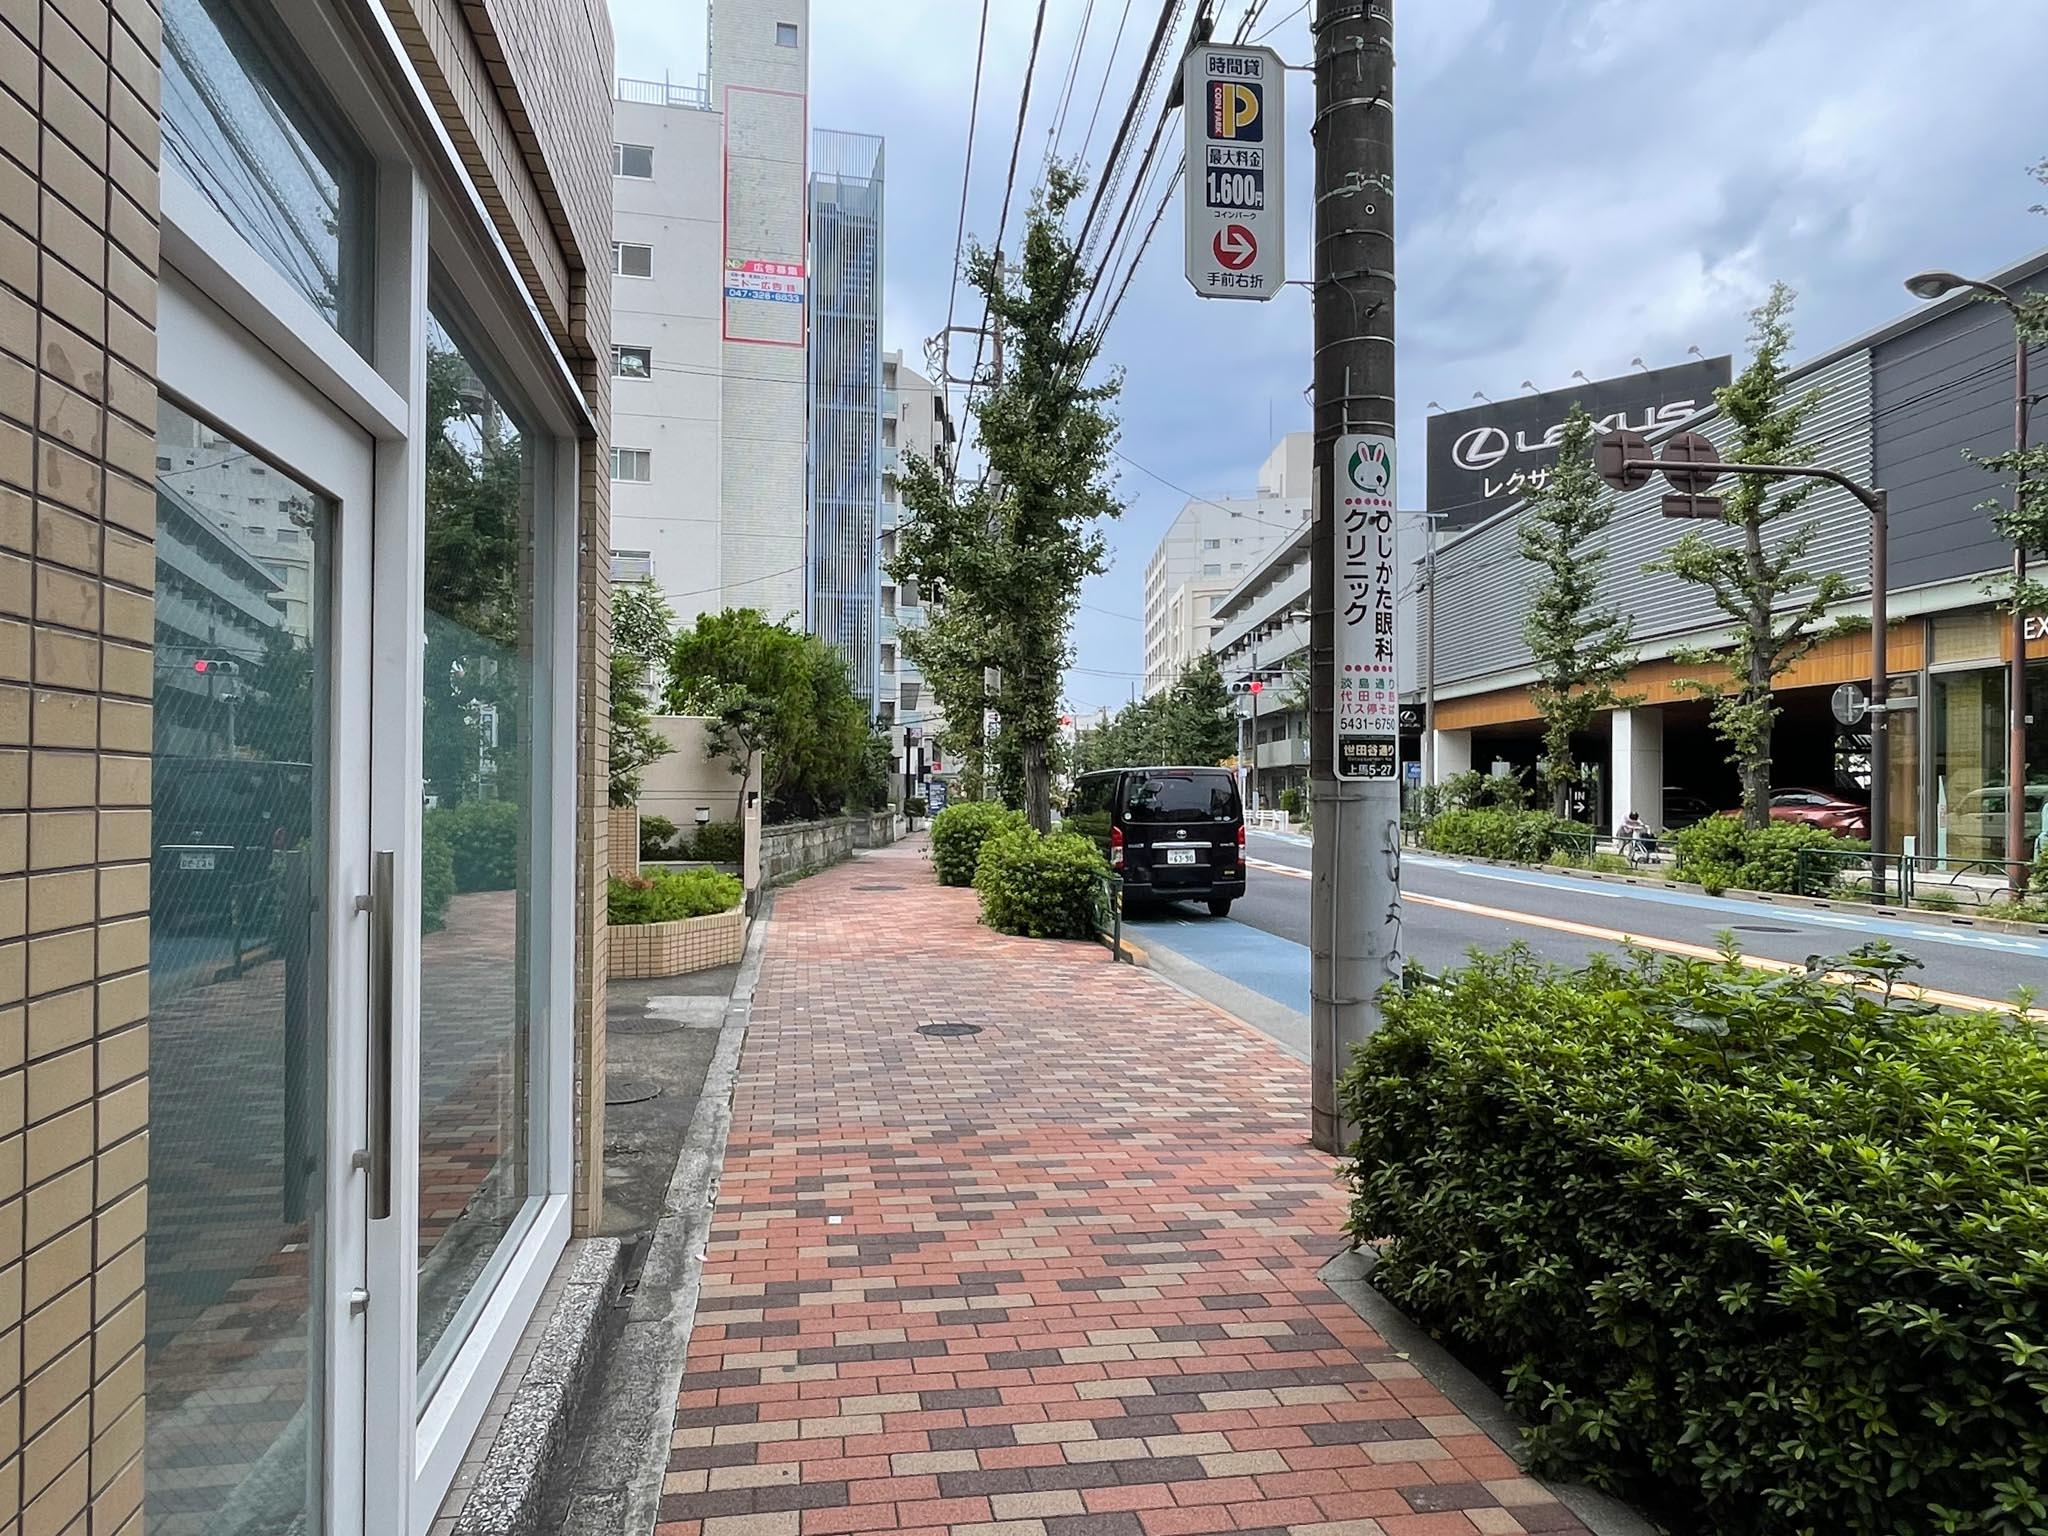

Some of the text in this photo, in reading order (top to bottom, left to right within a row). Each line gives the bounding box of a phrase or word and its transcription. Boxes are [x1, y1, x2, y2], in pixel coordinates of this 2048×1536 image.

[1209, 56, 1260, 77] 時間貸
[1214, 87, 1222, 134] COIN PARK
[1209, 148, 1261, 168] 最大料金
[1207, 171, 1263, 207] 1,600円
[1214, 210, 1257, 220] コインパーク
[1207, 272, 1264, 289] 手前右折
[1344, 509, 1369, 626] クリニック
[1375, 510, 1393, 663] ひじかた眼科
[1341, 677, 1395, 690] 淡島通り
[1340, 717, 1396, 730] 5431-6750
[1343, 744, 1395, 757] 世田谷通り
[1574, 791, 1586, 801] IN
